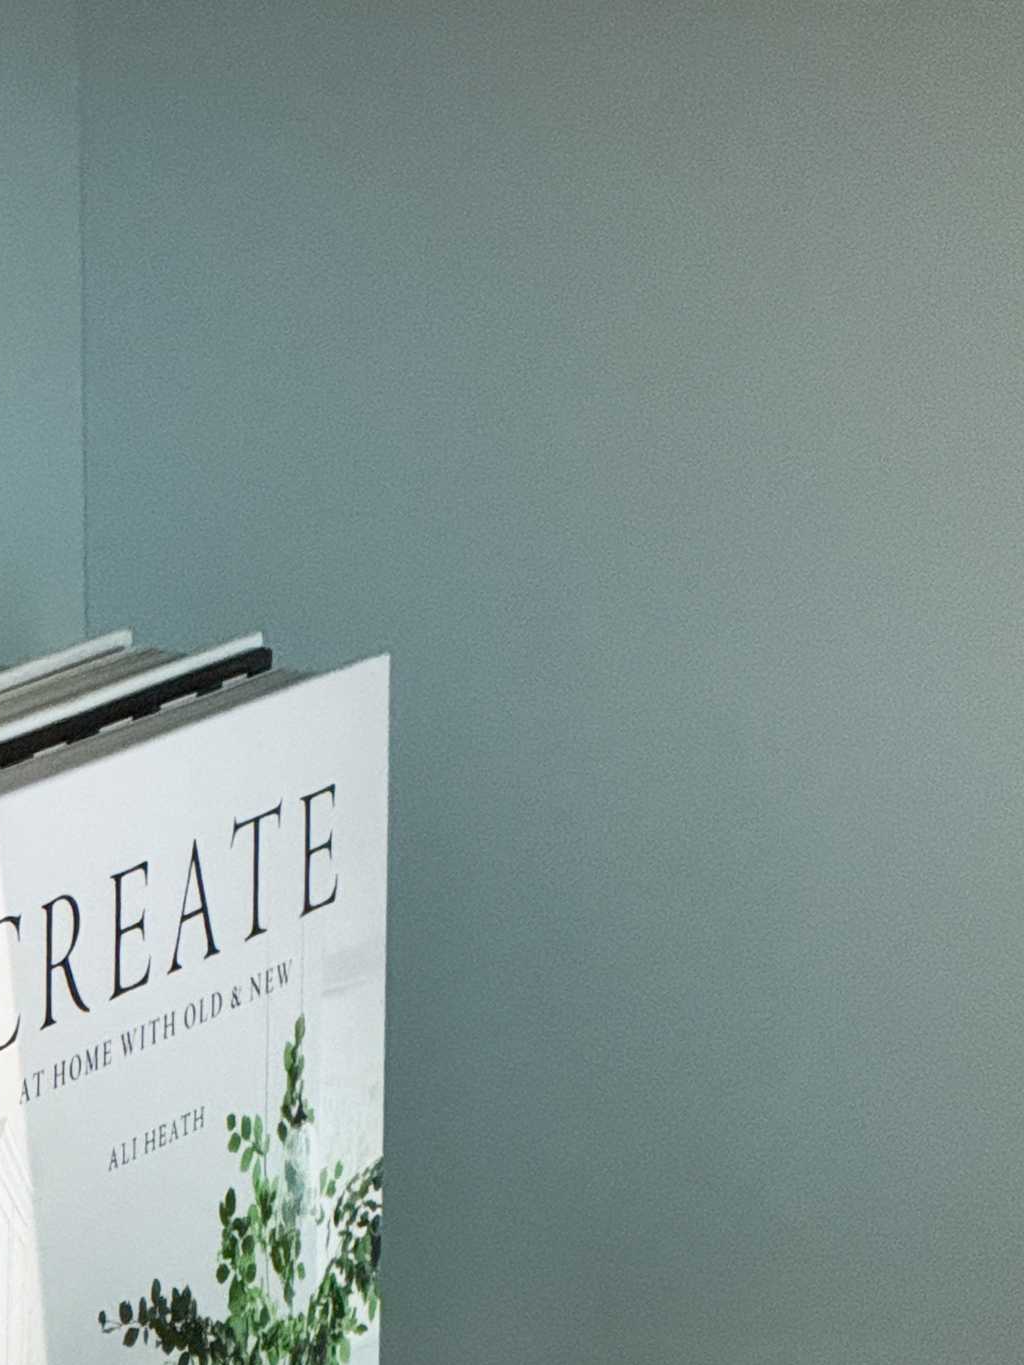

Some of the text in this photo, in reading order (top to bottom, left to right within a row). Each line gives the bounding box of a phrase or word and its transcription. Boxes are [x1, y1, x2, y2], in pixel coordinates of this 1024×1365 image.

[19, 958, 293, 1104] AT HOME WITH OLD & NEW
[108, 1105, 206, 1172] ALI HEATH
